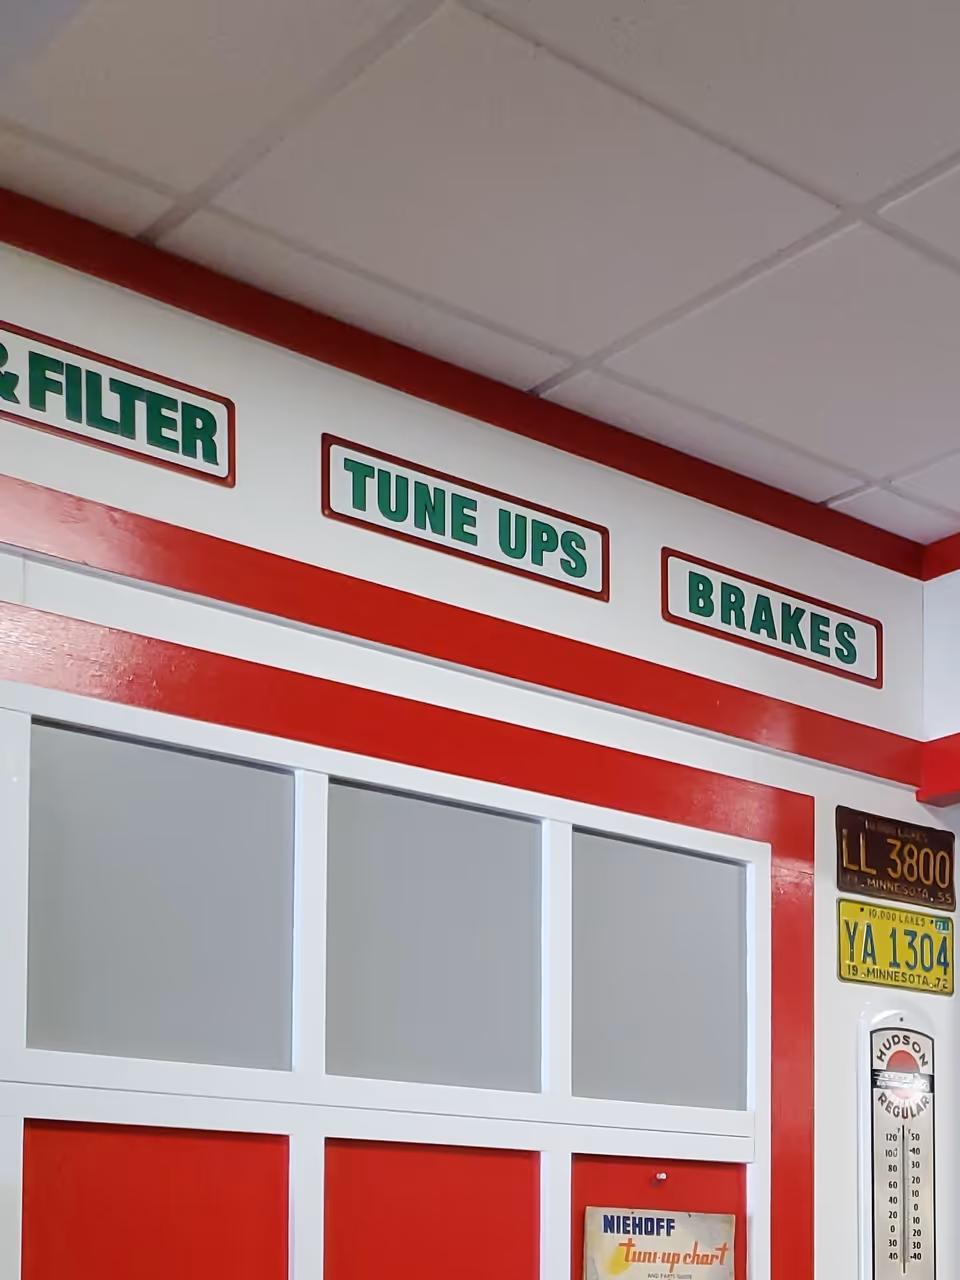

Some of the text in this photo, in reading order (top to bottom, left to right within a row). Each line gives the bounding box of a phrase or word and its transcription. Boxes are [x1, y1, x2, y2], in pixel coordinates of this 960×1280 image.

[28, 350, 219, 466] FILTER
[343, 457, 588, 579] TUNE UPS
[687, 570, 858, 666] BRAKES
[842, 828, 950, 889] LL 3800
[866, 878, 930, 899] MINNESOTA
[898, 913, 926, 926] LAKES
[844, 918, 950, 976] YA 1304
[846, 964, 949, 989] 19 MINNESOTA 72
[876, 1034, 929, 1068] HUDSON
[877, 1092, 930, 1119] REGULAR
[885, 1133, 920, 1141] 120 50
[888, 1164, 898, 1172] 80
[888, 1176, 921, 1189] 60 20
[889, 1196, 898, 1204] 40
[602, 1214, 676, 1237] NIEHOFF
[888, 1211, 898, 1219] 20
[890, 1225, 896, 1233] 0
[912, 1229, 921, 1237] 20
[682, 1240, 729, 1266] chart
